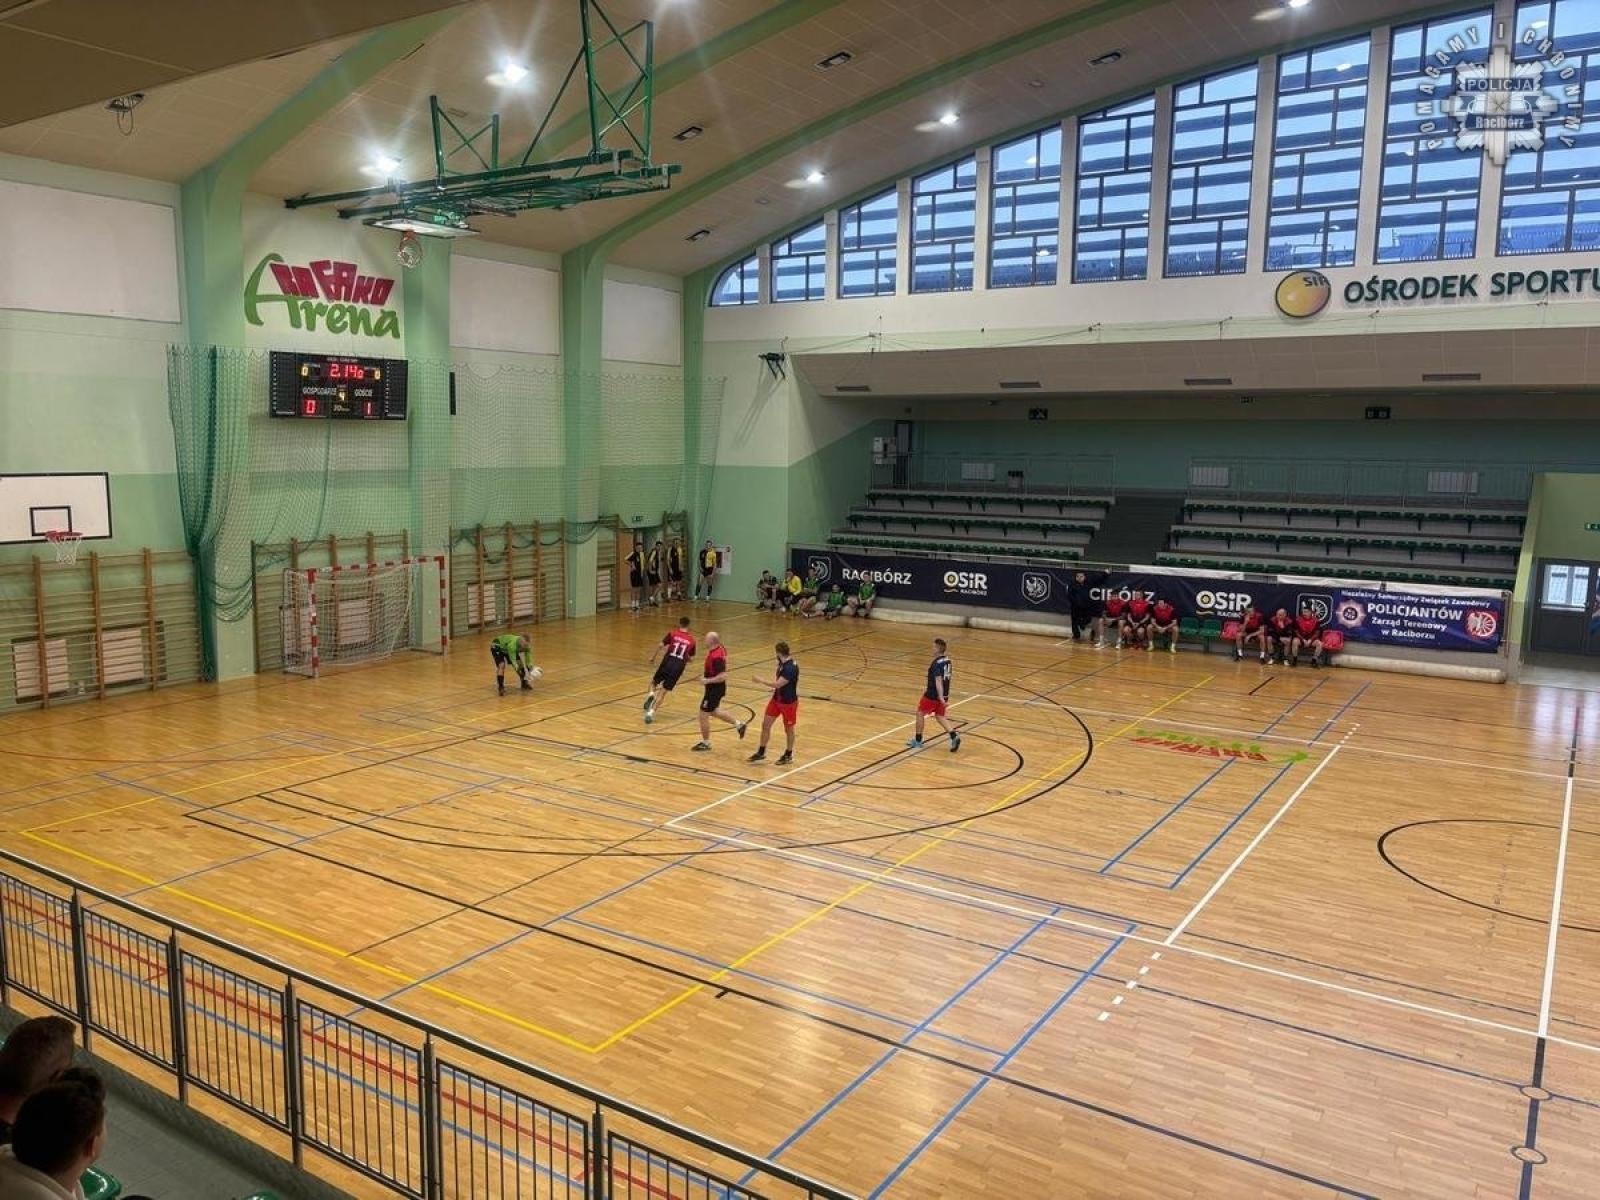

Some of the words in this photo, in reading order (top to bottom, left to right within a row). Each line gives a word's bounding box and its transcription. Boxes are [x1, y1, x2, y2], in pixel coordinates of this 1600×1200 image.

[244, 252, 401, 339] Arena
[1344, 273, 1479, 303] OŚRODEK
[943, 571, 987, 589] OSiR
[1195, 590, 1252, 611] OSiR
[1367, 603, 1463, 620] POLICJANTÓW
[1371, 616, 1401, 628] Zarząd
[1403, 618, 1447, 632] Terenowy
[1391, 629, 1436, 639] Raciborzu
[670, 642, 687, 660] 11
